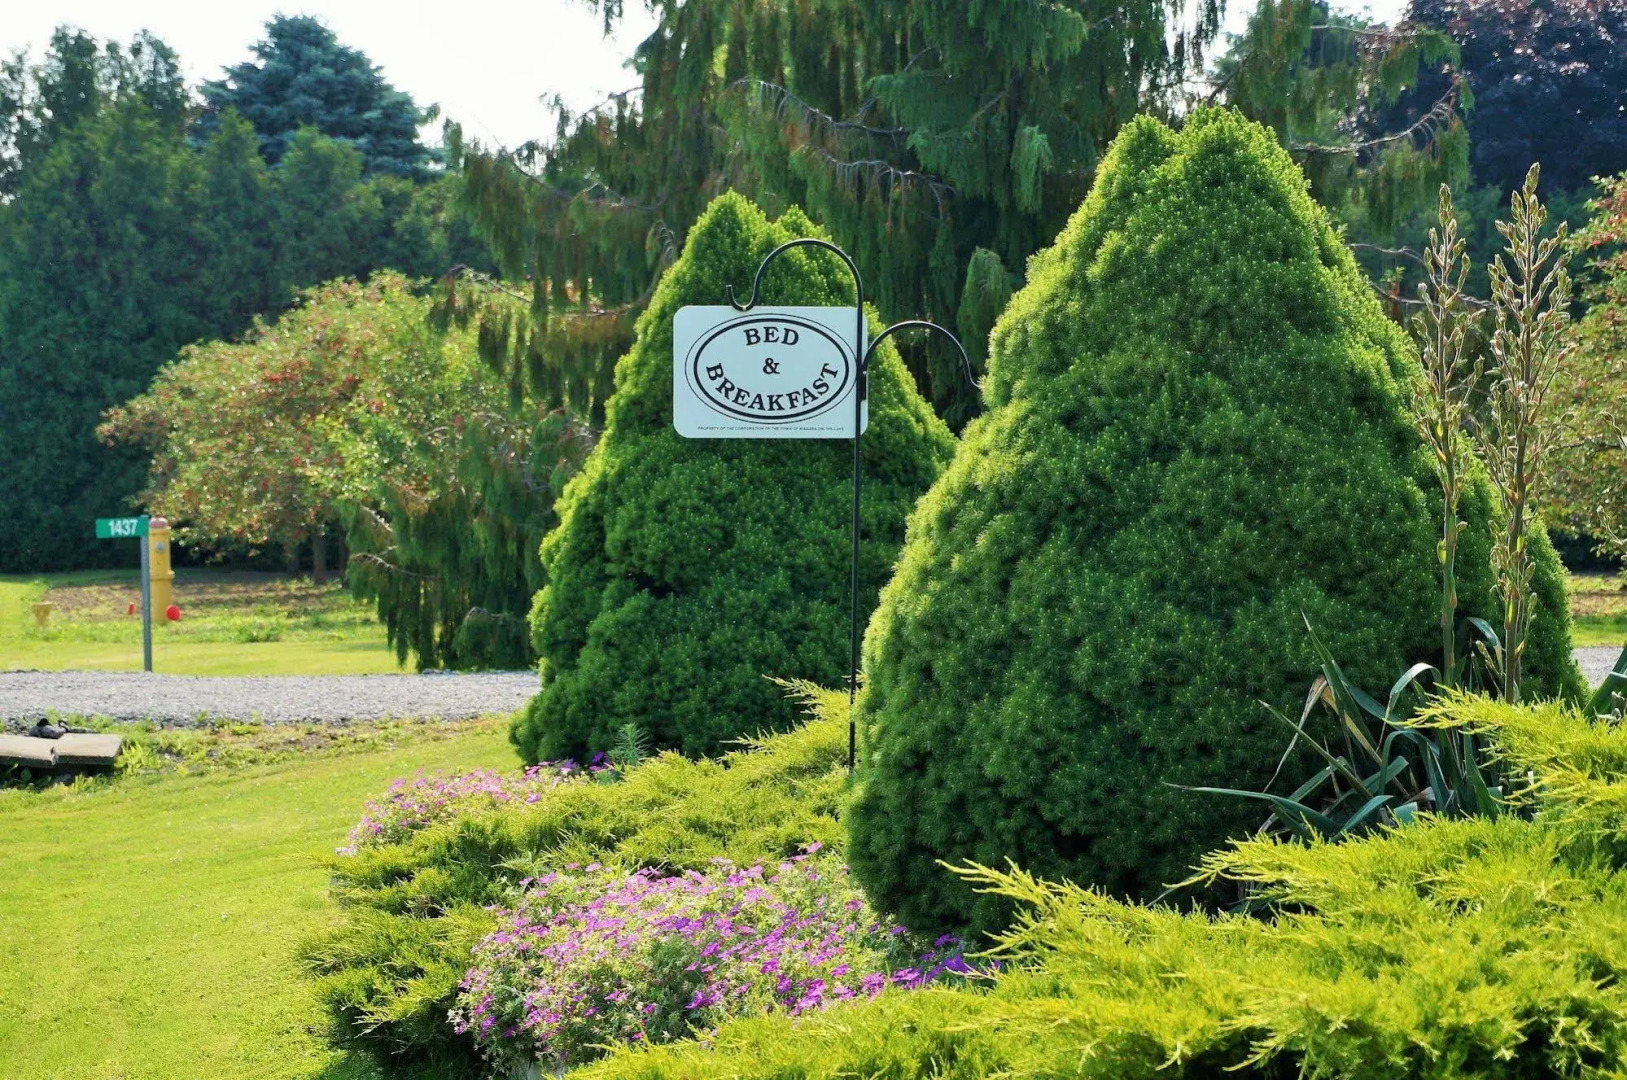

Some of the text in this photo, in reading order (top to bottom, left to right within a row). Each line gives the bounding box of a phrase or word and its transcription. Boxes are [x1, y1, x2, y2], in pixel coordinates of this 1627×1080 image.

[743, 326, 800, 346] BED
[762, 357, 780, 375] &
[706, 362, 839, 412] BREAKFAST
[108, 518, 138, 536] 1437
